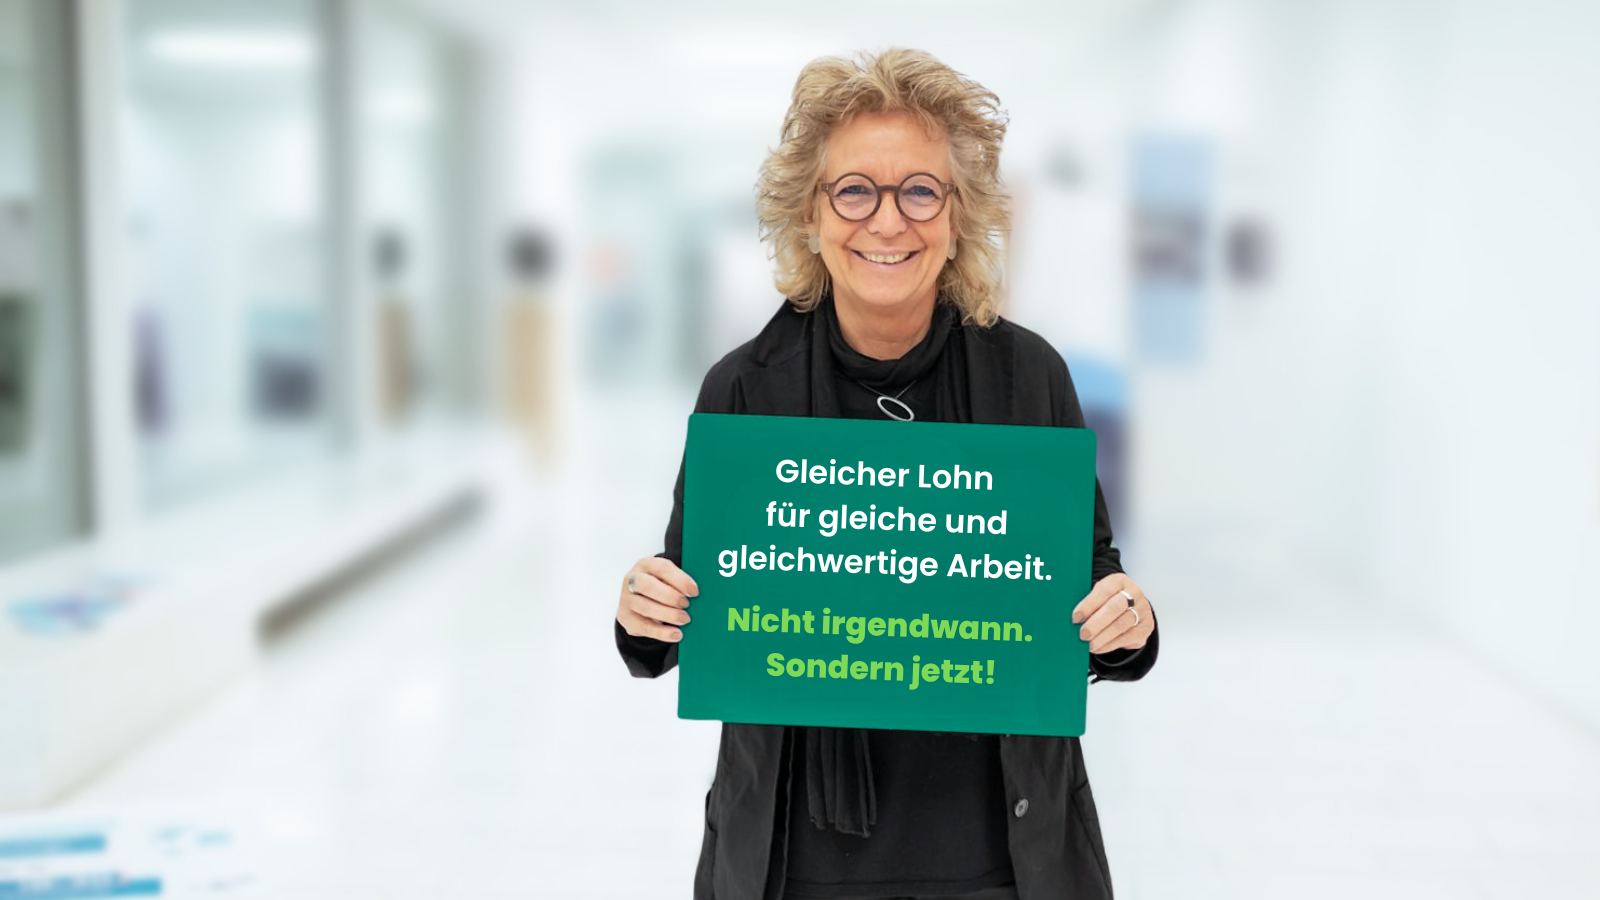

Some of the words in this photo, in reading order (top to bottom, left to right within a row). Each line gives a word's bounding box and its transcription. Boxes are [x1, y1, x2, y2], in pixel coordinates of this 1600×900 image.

[775, 458, 910, 488] Gleicher
[918, 464, 993, 491] Lohn
[765, 500, 811, 528] für
[818, 504, 938, 538] gleiche
[945, 510, 1008, 537] und
[717, 544, 939, 584] gleichwertige
[946, 553, 1052, 581] Arbeit.
[727, 605, 815, 635] Nicht
[822, 608, 1033, 644] irgendwann.
[766, 652, 904, 682] Sondern
[909, 655, 995, 690] jetzt!
